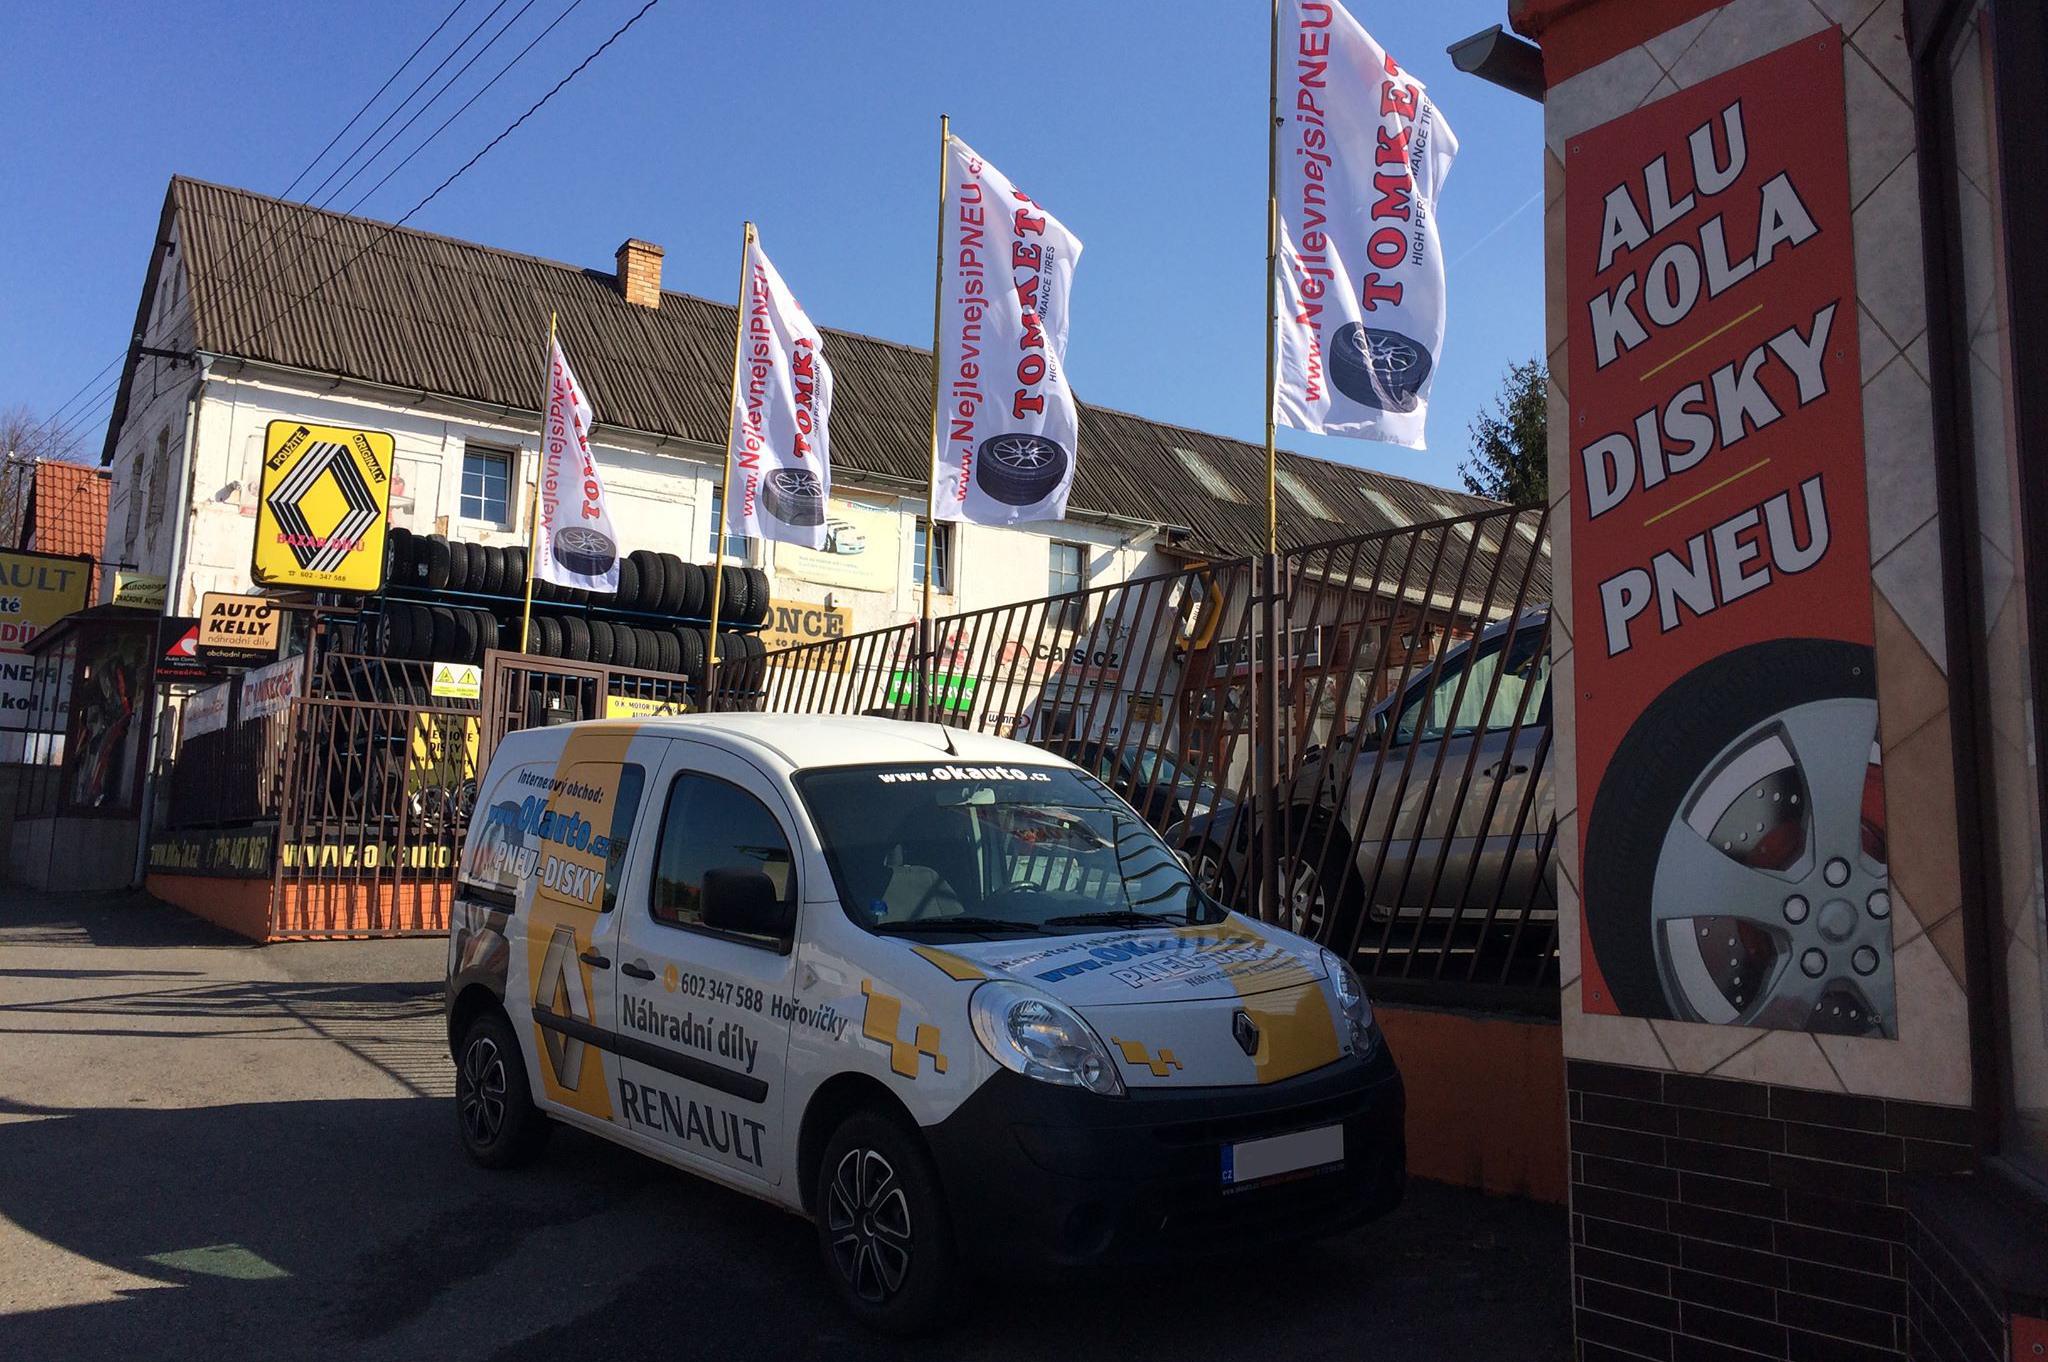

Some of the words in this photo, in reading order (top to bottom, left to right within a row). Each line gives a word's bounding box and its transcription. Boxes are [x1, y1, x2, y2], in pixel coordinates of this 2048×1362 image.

[1597, 96, 1748, 277] ALU
[1044, 245, 1055, 277] TIRES
[1411, 228, 1425, 266] HIGH
[1587, 169, 1823, 373] KOLA
[950, 157, 989, 501] www.NejlevnejsiPNEU.cz
[1012, 207, 1047, 420] TOMKET
[1579, 297, 1842, 521] DISKY
[272, 430, 308, 467] POUŽITÉ
[276, 533, 326, 548] BAZAR
[1598, 472, 1833, 659] PNEU
[208, 619, 271, 636] KELLY
[211, 602, 271, 619] AUTO
[566, 780, 604, 804] obchod:
[877, 765, 1052, 784] www.okauto.cz
[681, 972, 706, 999] 602
[708, 979, 734, 1005] 347
[735, 987, 764, 1013] 588
[770, 993, 849, 1041] Hořovičky
[623, 993, 713, 1052] Náhradní
[717, 1022, 759, 1074] díly
[617, 1077, 768, 1168] RENAULT
[1222, 1169, 1233, 1180] CZ
